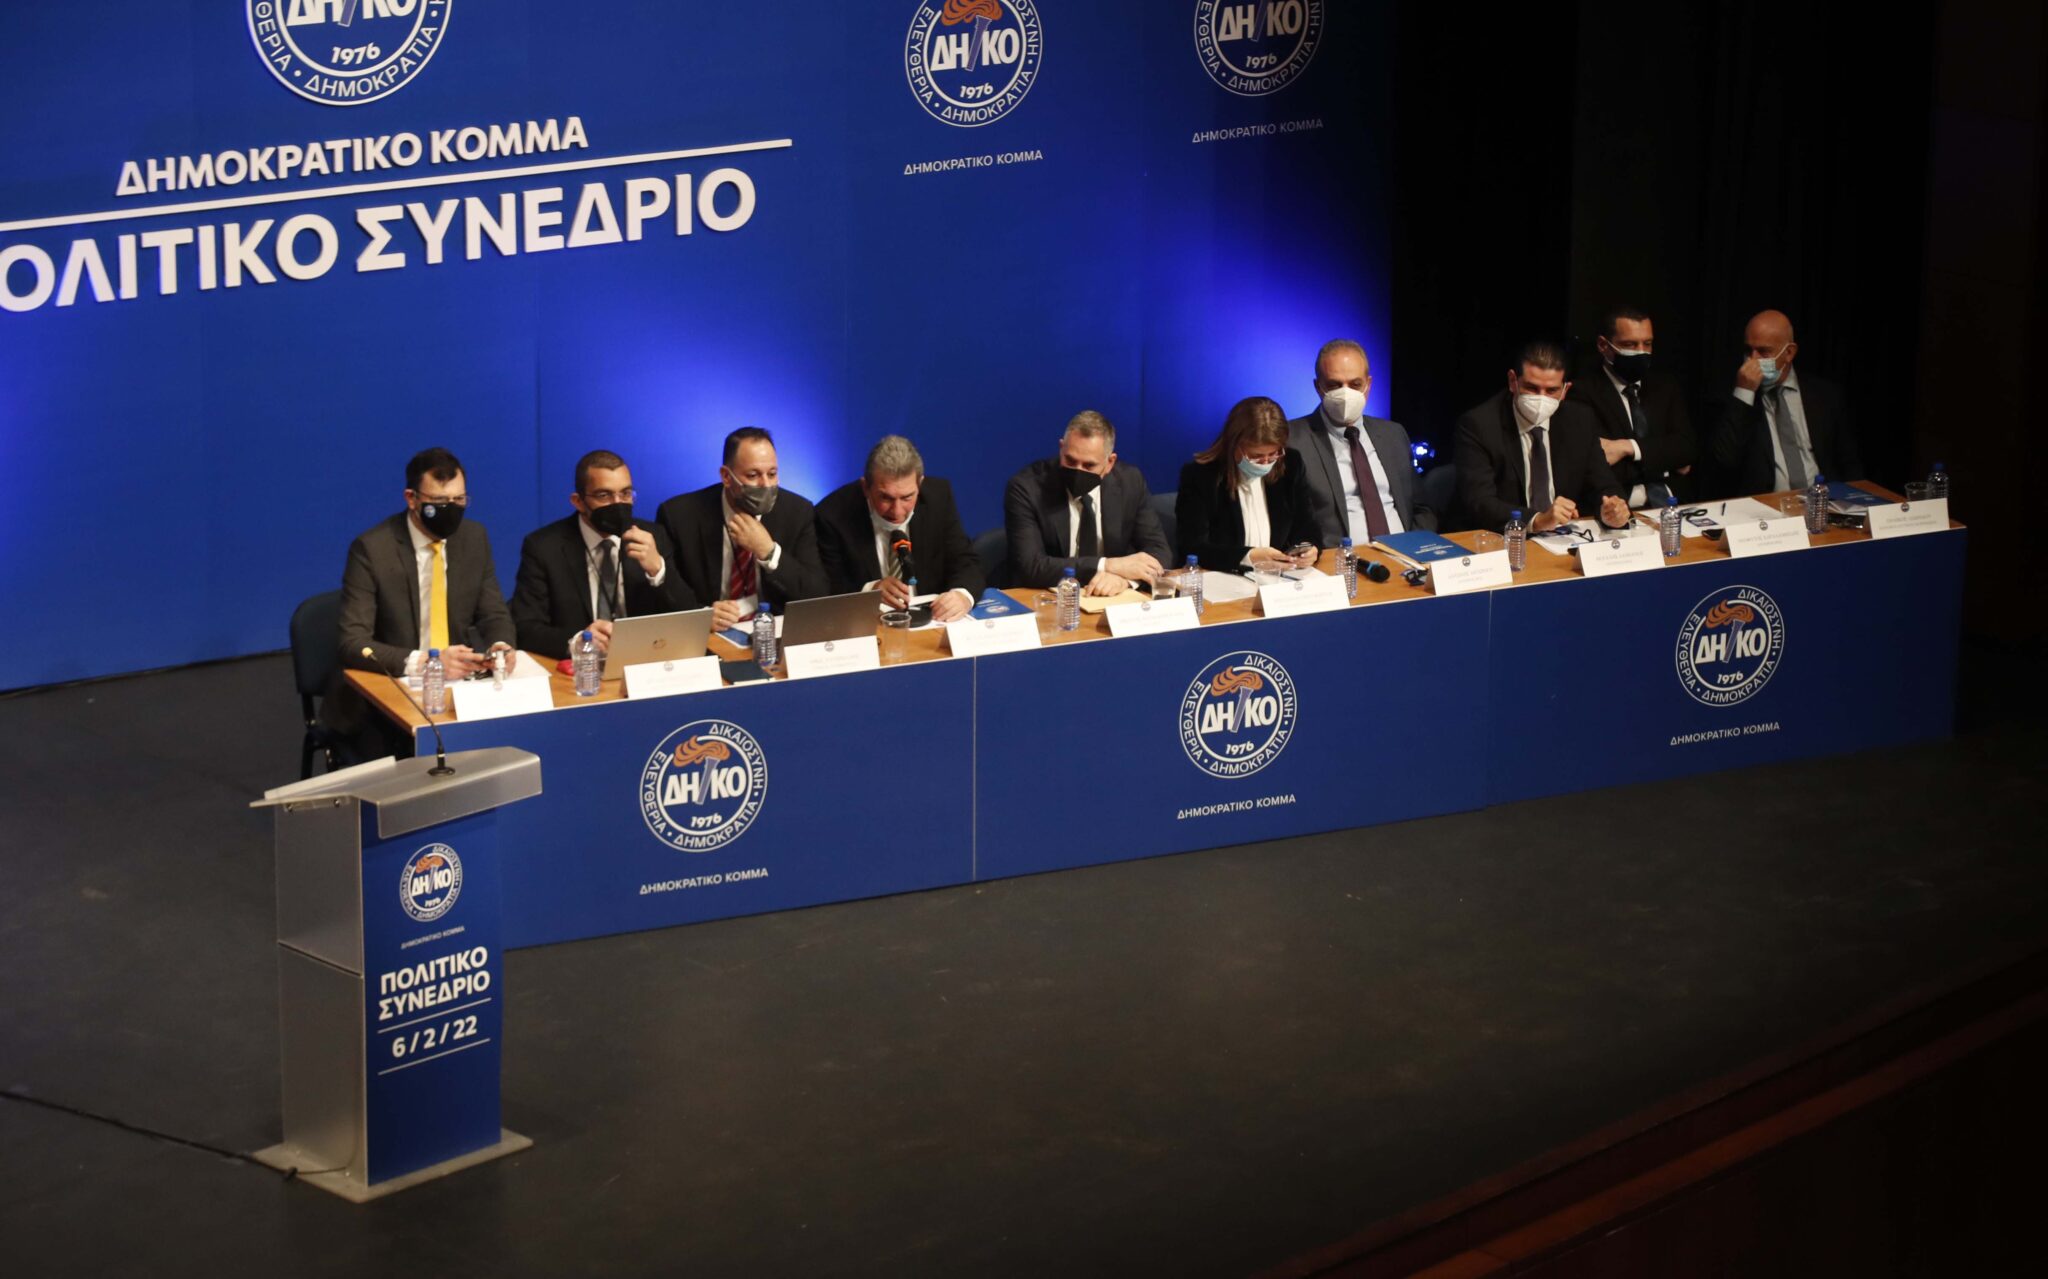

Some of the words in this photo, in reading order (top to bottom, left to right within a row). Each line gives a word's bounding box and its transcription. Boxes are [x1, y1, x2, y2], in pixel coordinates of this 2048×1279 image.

[304, 26, 438, 98] ΔΗΜΟΚΡΑΤΙΑ
[331, 42, 381, 65] 1976
[909, 6, 935, 103] ΕΛΕΥΘΕΡΙΑ
[1227, 41, 1314, 92] ΔΗΜΟΚΡΑΤΙΑ
[1246, 53, 1277, 69] 1976
[941, 71, 1033, 122] ΔΗΜΟΚΡΑΤΙΑ
[960, 83, 993, 99] 1976
[1192, 124, 1276, 143] ΔΗΜΟΚΡΑΤΙΚΟ
[1280, 118, 1323, 133] ΚΟΜΜΑ
[115, 131, 422, 196] ΔΗΜΟΚΡΑΤΙΚΟ
[430, 117, 588, 161] ΚΟΜΜΑ
[903, 155, 993, 175] ΔΗΜΟΚΡΑΤΙΚΟ
[997, 150, 1043, 165] ΚΟΜΜΑ
[355, 168, 757, 272] ΣΥΝΕΔΡΙΟ
[1738, 589, 1781, 649] ΔΙΚΑΙΟΣΥΝΗ
[1678, 613, 1701, 690] ΕΛΕΥΘΕΡΙΑ
[1244, 654, 1293, 718] ΔΙΚΑΙΟΣΥΝΗ
[1702, 660, 1775, 703] ΔΗΜΟΚΡΑΤΙΑ
[1717, 671, 1744, 685] 1976
[1183, 680, 1205, 761] ΕΛΕΥΘΕΡΙΑ
[1670, 728, 1741, 746] ΔΗΜΟΚΡΑΤΙΚΟ
[1743, 722, 1780, 735] ΚΟΜΜΑ
[708, 723, 764, 789] ΔΙΚΑΙΟΣΥΝΗ
[1209, 730, 1288, 774] ΔΗΜΟΚΡΑΤΙΑ
[1225, 741, 1255, 755] 1976
[644, 750, 667, 834] ΕΛΕΥΘΕΡΙΑ
[1177, 799, 1254, 819] ΔΗΜΟΚΡΑΤΙΚΟ
[1256, 793, 1296, 808] ΚΟΜΜΑ
[674, 801, 759, 848] ΔΗΜΟΚΡΑΤΙΑ
[690, 813, 722, 828] 1976
[639, 874, 723, 895] ΔΗΜΟΚΡΑΤΙΚΟ
[725, 867, 769, 883] ΚΟΜΜΑ
[378, 970, 491, 1020] ΣΥΝΕΔΡΙΟ
[380, 946, 488, 996] ΠΟΛΙΤΙΚΟ
